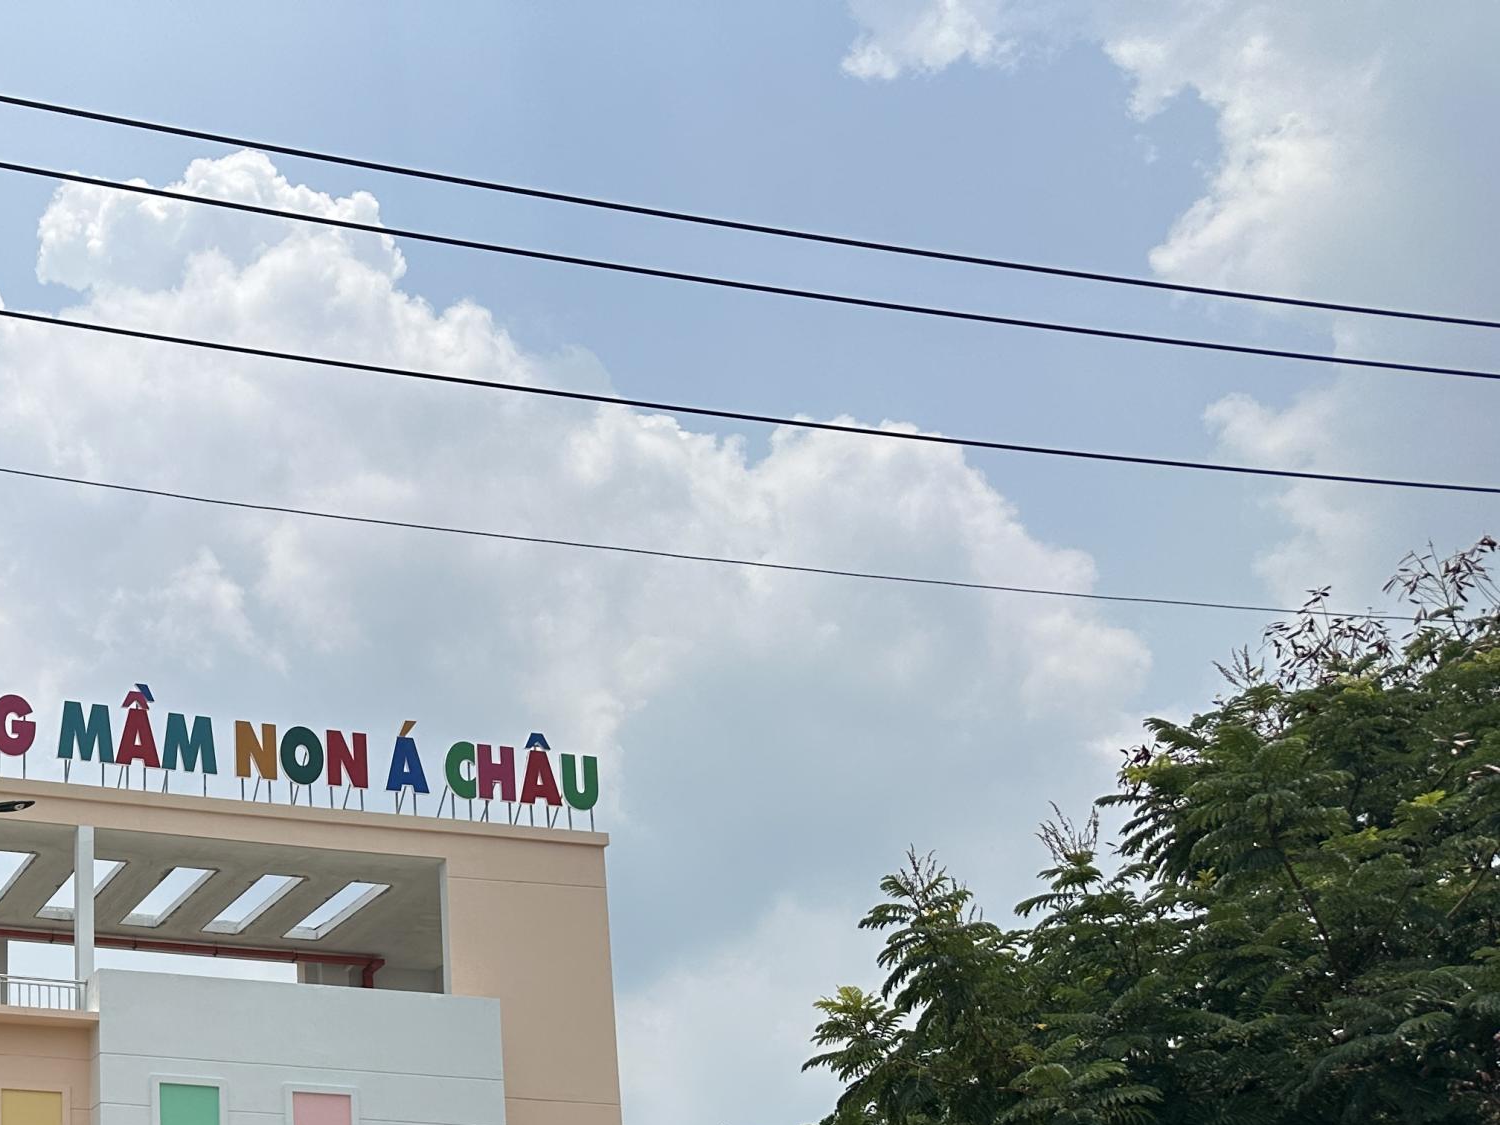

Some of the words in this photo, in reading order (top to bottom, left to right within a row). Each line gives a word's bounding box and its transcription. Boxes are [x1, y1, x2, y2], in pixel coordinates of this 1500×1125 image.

[57, 683, 217, 775] MẦM
[235, 720, 368, 789] NON
[386, 720, 430, 794] Á
[445, 732, 599, 811] CHÂU
